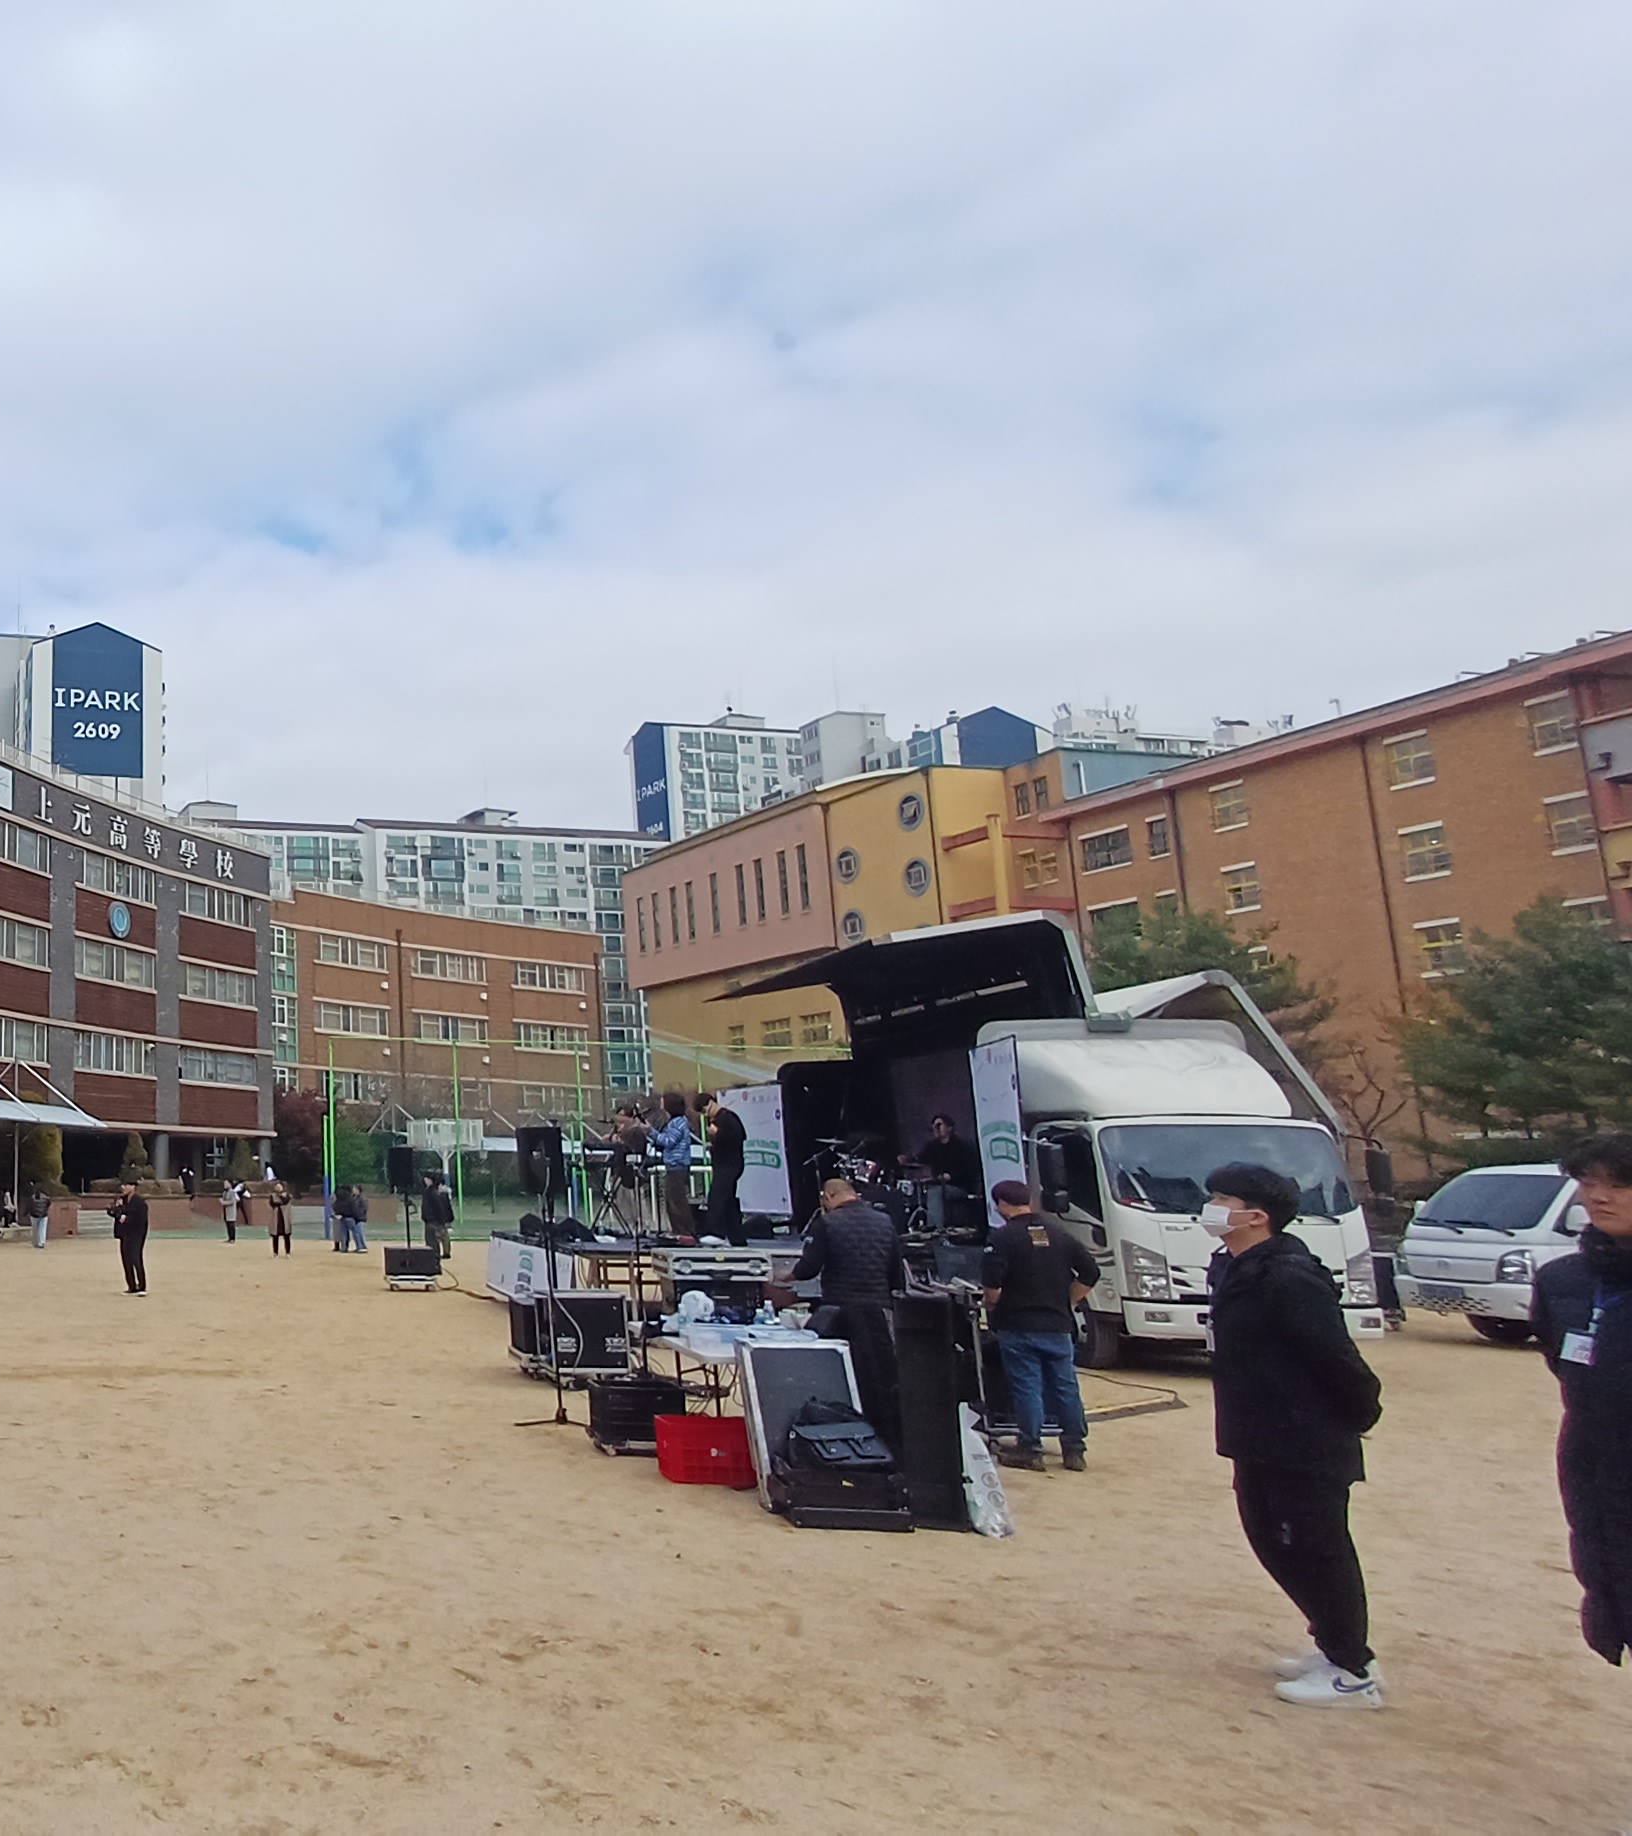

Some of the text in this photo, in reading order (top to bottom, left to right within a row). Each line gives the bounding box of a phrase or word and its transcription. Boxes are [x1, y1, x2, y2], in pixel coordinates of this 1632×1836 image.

[54, 687, 141, 712] IPARK
[73, 721, 121, 740] 2609
[636, 777, 666, 802] IPARK
